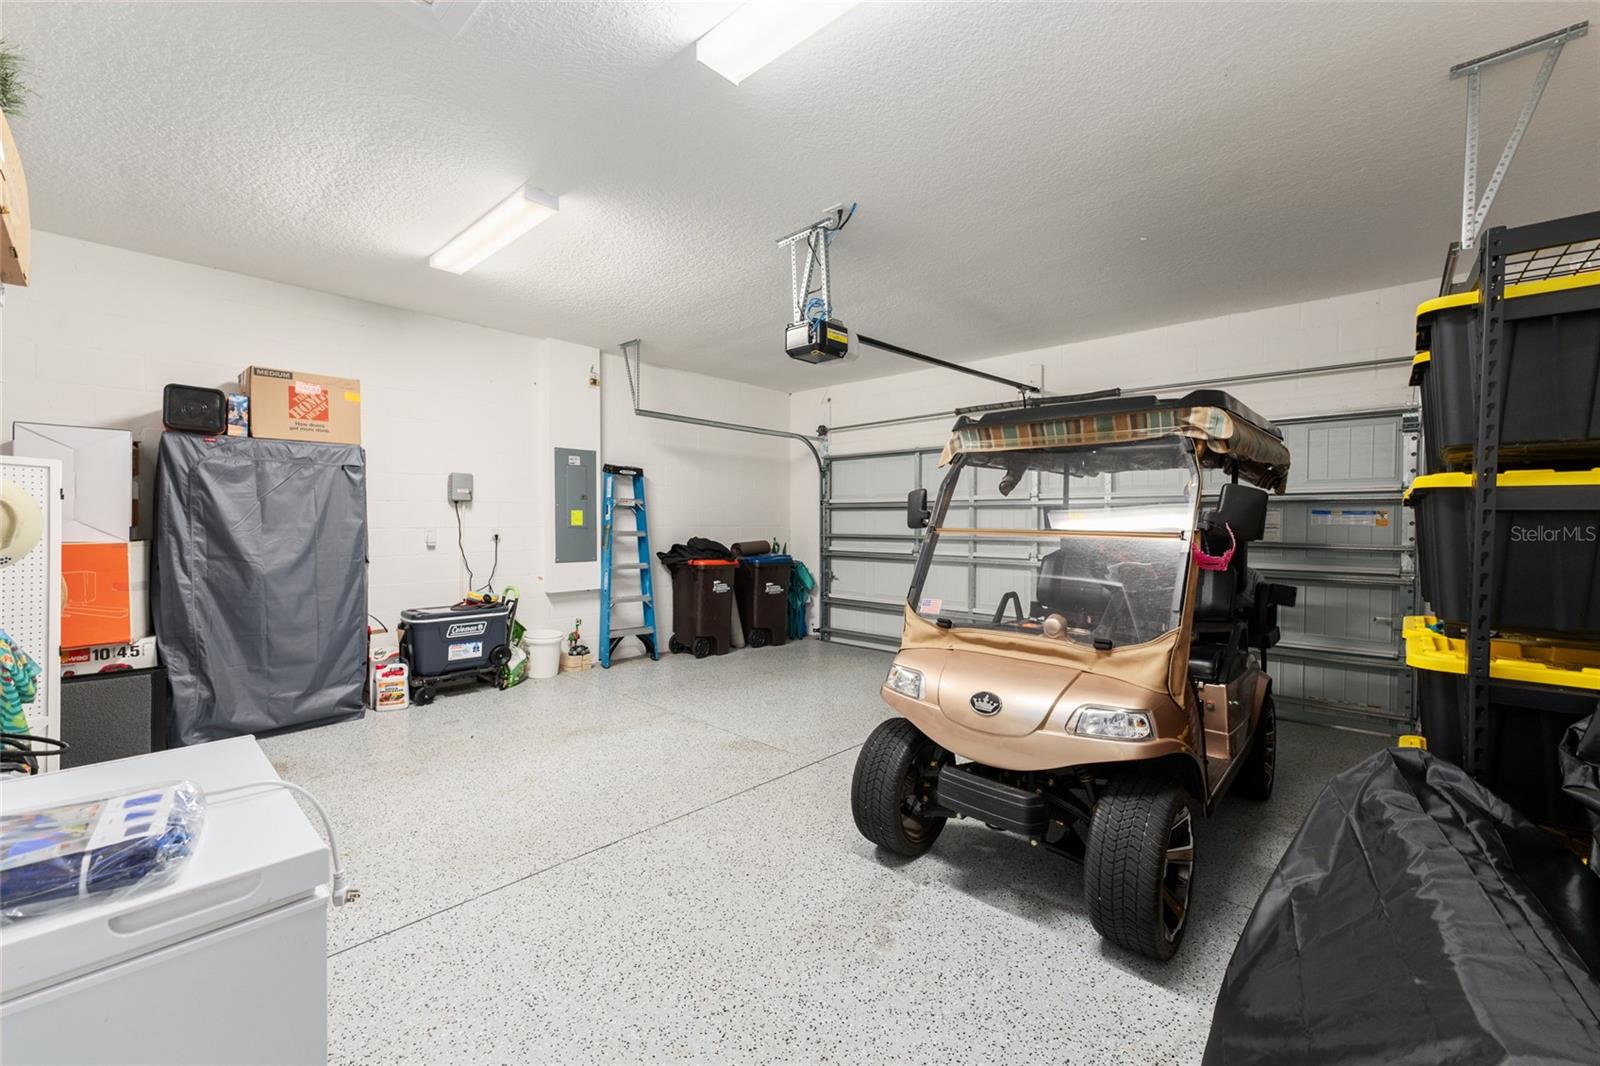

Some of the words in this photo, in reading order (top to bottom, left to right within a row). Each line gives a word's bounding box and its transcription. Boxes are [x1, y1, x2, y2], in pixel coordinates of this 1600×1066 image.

[256, 369, 291, 379] MEDIUM
[289, 392, 328, 418] HOME
[305, 402, 328, 420] DEPOT
[451, 625, 477, 634] Coleman
[92, 648, 110, 661] 10
[117, 645, 140, 658] 4.5
